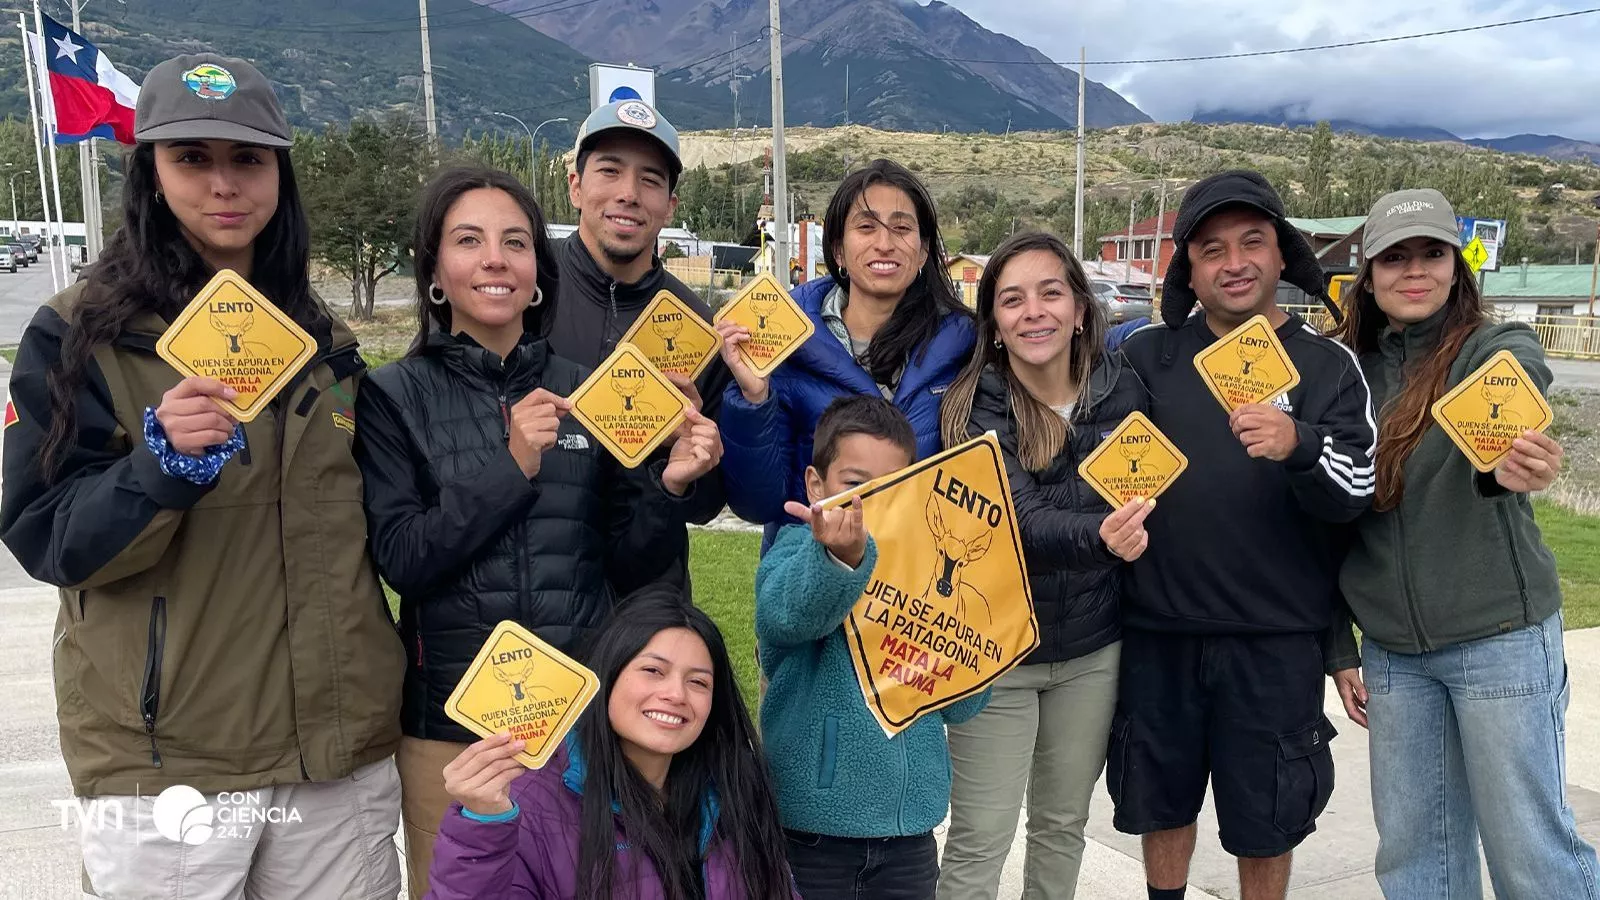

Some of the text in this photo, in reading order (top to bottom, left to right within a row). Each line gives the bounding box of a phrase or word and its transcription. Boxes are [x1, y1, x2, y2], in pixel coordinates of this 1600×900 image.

[1386, 200, 1434, 217] REWILDING
[751, 292, 779, 302] LENTO
[209, 302, 254, 313] LENTO
[652, 313, 682, 323] LENTO
[1240, 336, 1270, 349] LENTO
[192, 358, 284, 368] QUIEN SE APURA EN
[205, 369, 218, 377] LA
[611, 369, 645, 378] LENTO
[220, 377, 247, 385] MATA
[1214, 372, 1234, 382] QUIEN
[1243, 379, 1265, 388] APURA
[1484, 376, 1518, 387] LENTO
[1227, 389, 1244, 397] MATA
[1457, 421, 1480, 429] QUIEN
[1493, 424, 1518, 432] APURA
[1120, 435, 1151, 444] LENTO
[932, 468, 1003, 528] LENTO
[864, 579, 1003, 663] UIEN SE APURA EN
[864, 603, 982, 676] LA PATAGONIA,
[491, 648, 533, 666] LENTO
[879, 634, 955, 681] MATA LA
[878, 659, 936, 697] FAUNA
[481, 696, 568, 722] QUIEN SE APURA EN
[493, 719, 506, 729] LA
[509, 719, 548, 733] MATA LA
[515, 729, 546, 741] FAUNA
